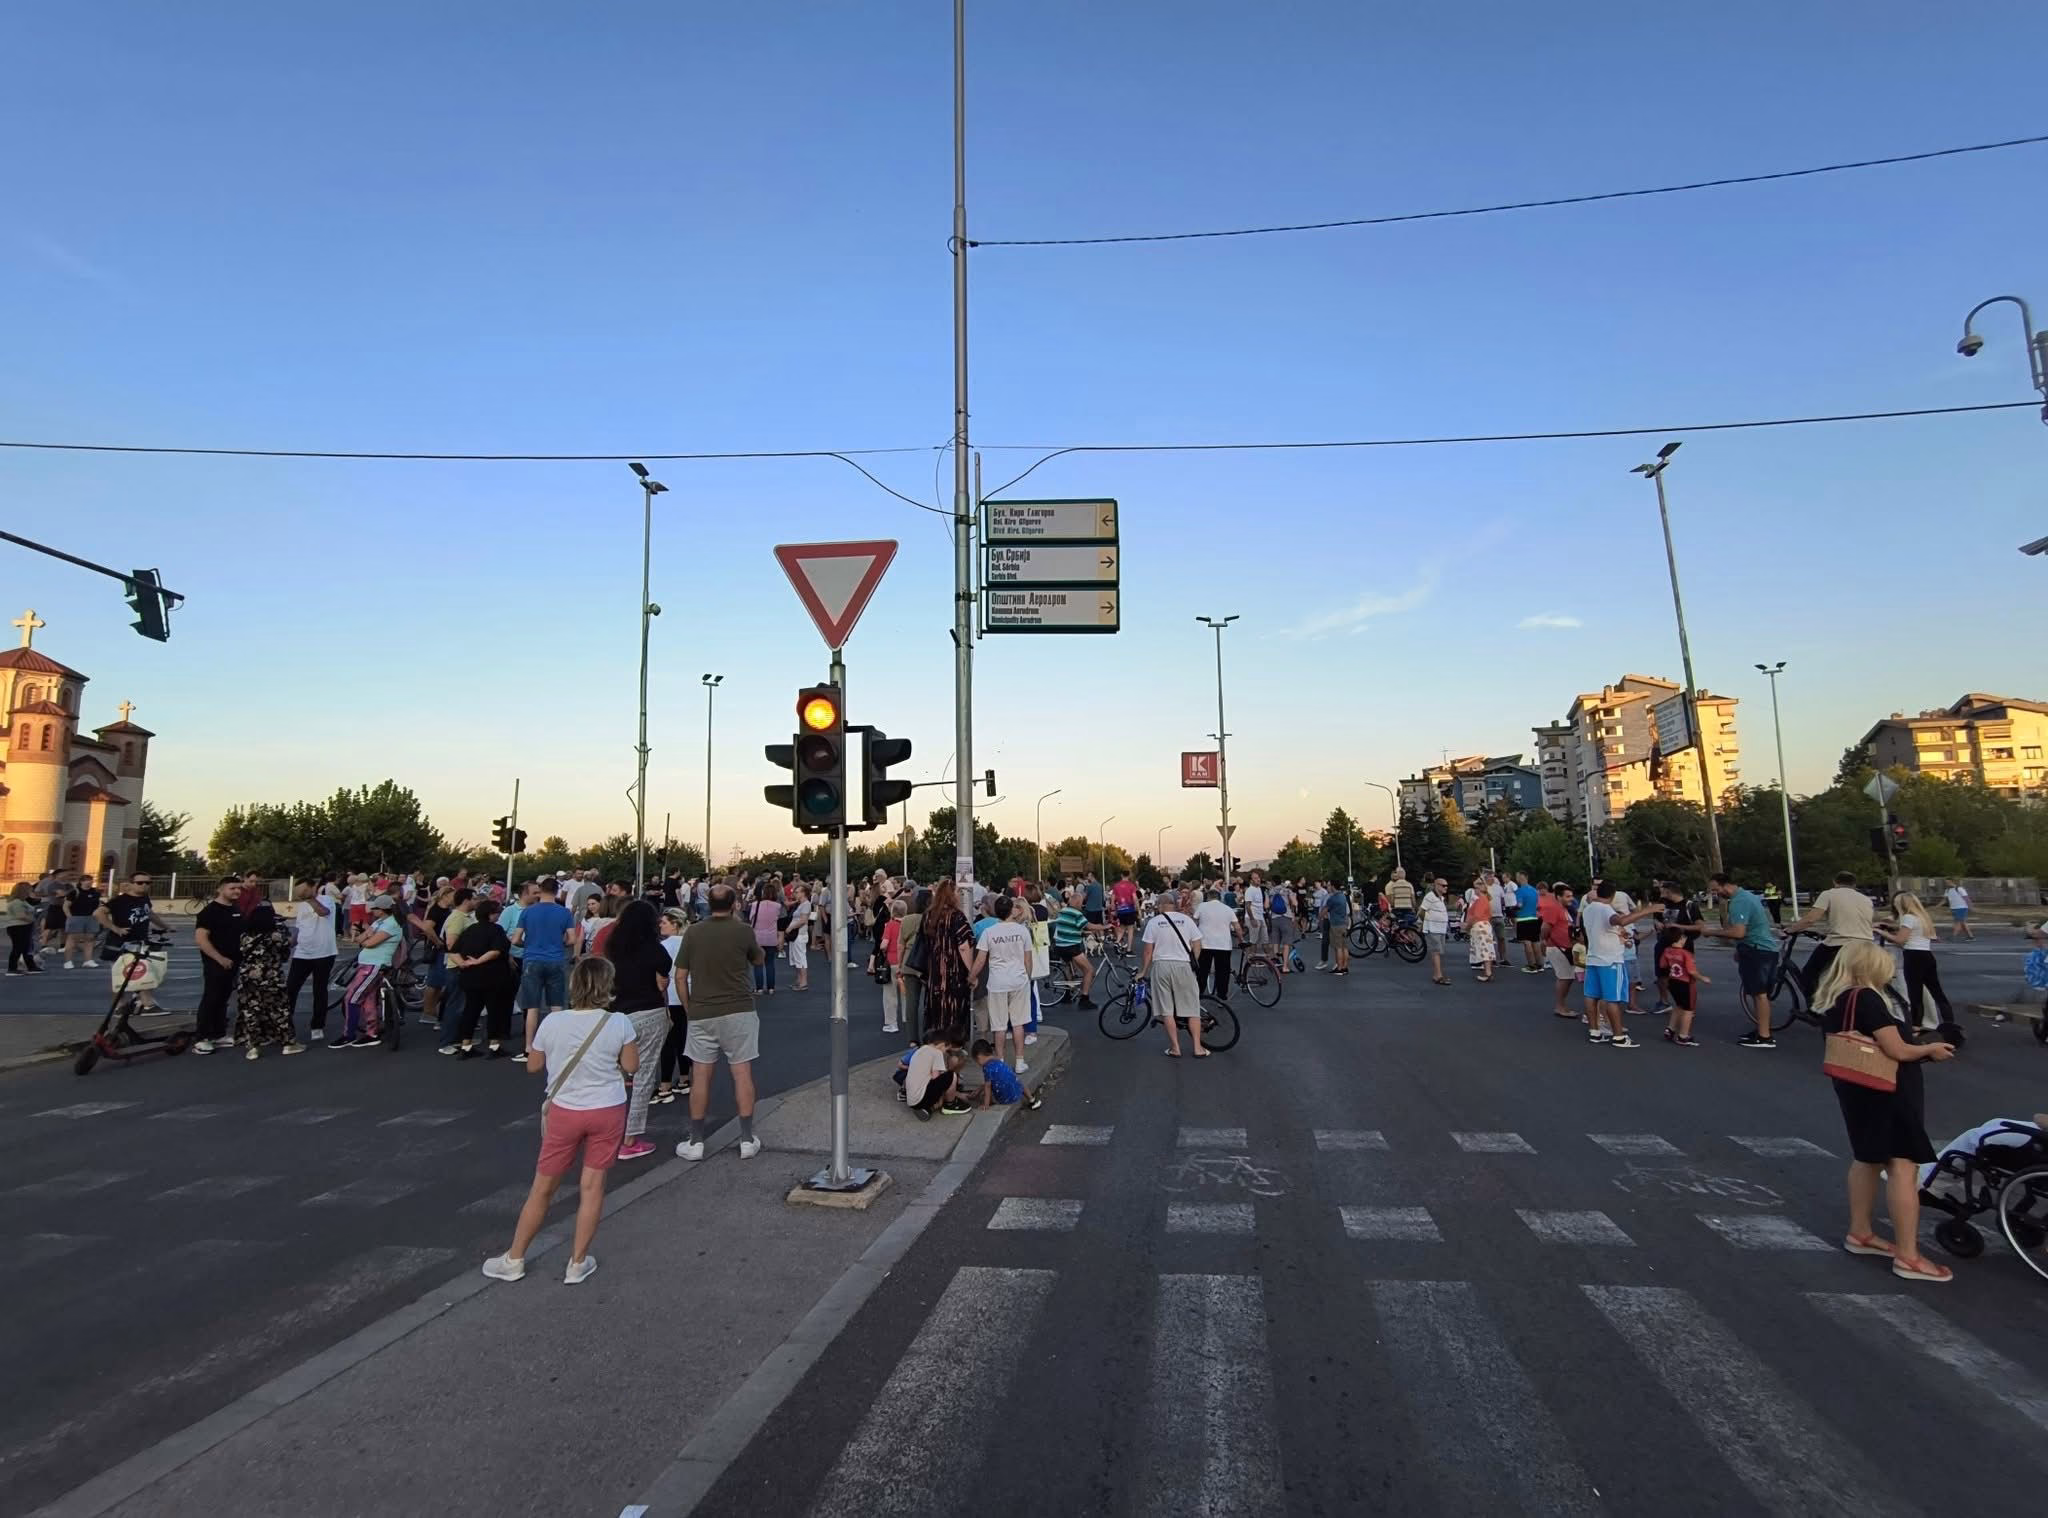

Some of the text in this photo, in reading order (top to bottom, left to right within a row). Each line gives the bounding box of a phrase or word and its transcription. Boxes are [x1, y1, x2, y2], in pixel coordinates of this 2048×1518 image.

[1006, 549, 1031, 563] Србија
[991, 592, 1067, 607] Општина Аеродром
